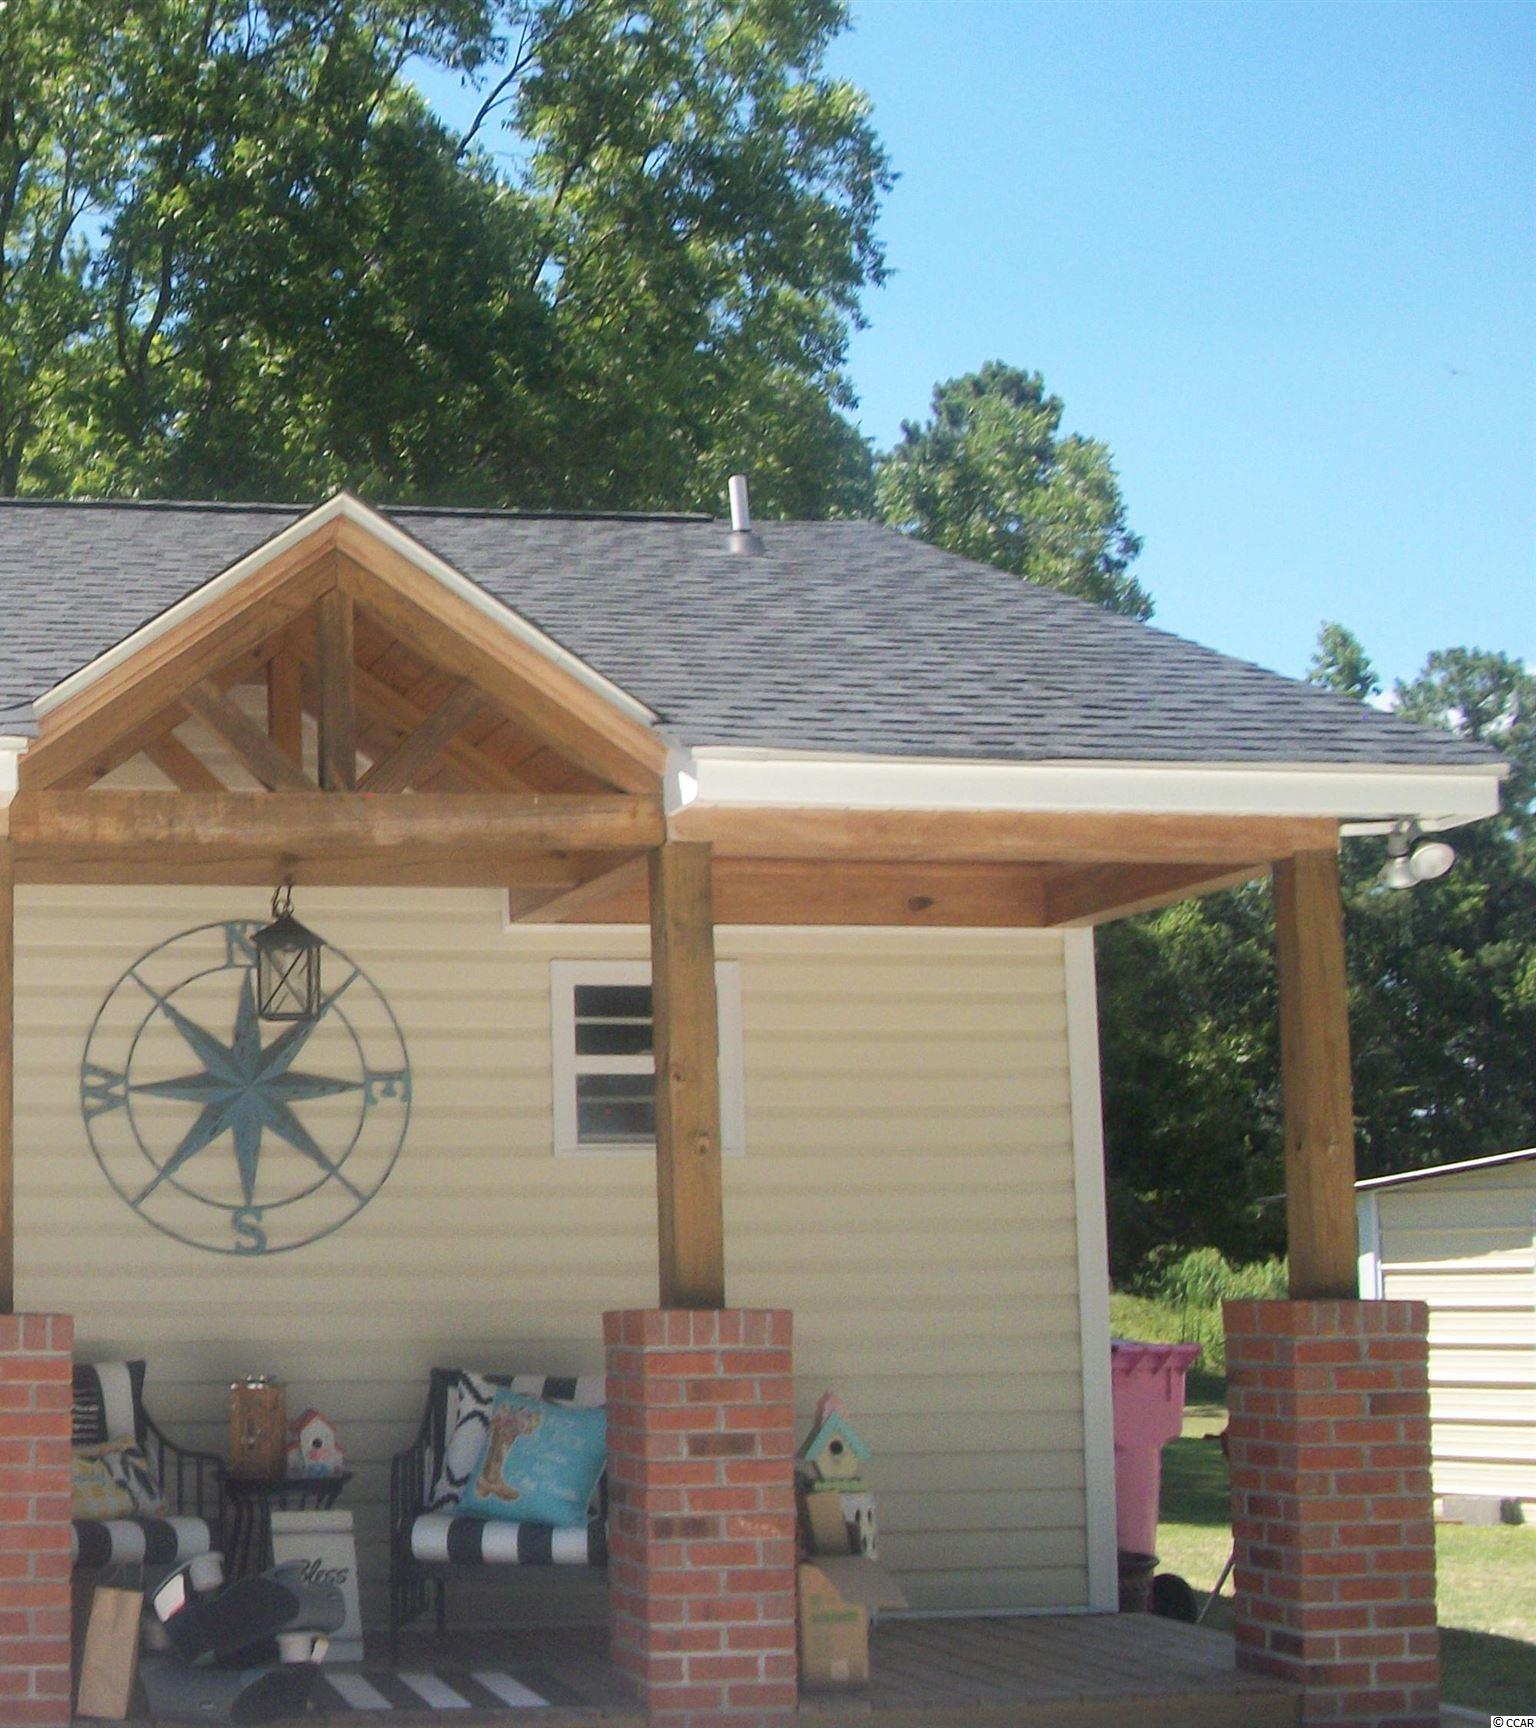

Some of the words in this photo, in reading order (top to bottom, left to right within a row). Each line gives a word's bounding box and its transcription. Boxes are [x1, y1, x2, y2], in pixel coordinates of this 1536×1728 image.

[81, 1062, 128, 1121] W
[365, 1067, 412, 1106] E
[231, 1206, 268, 1255] S
